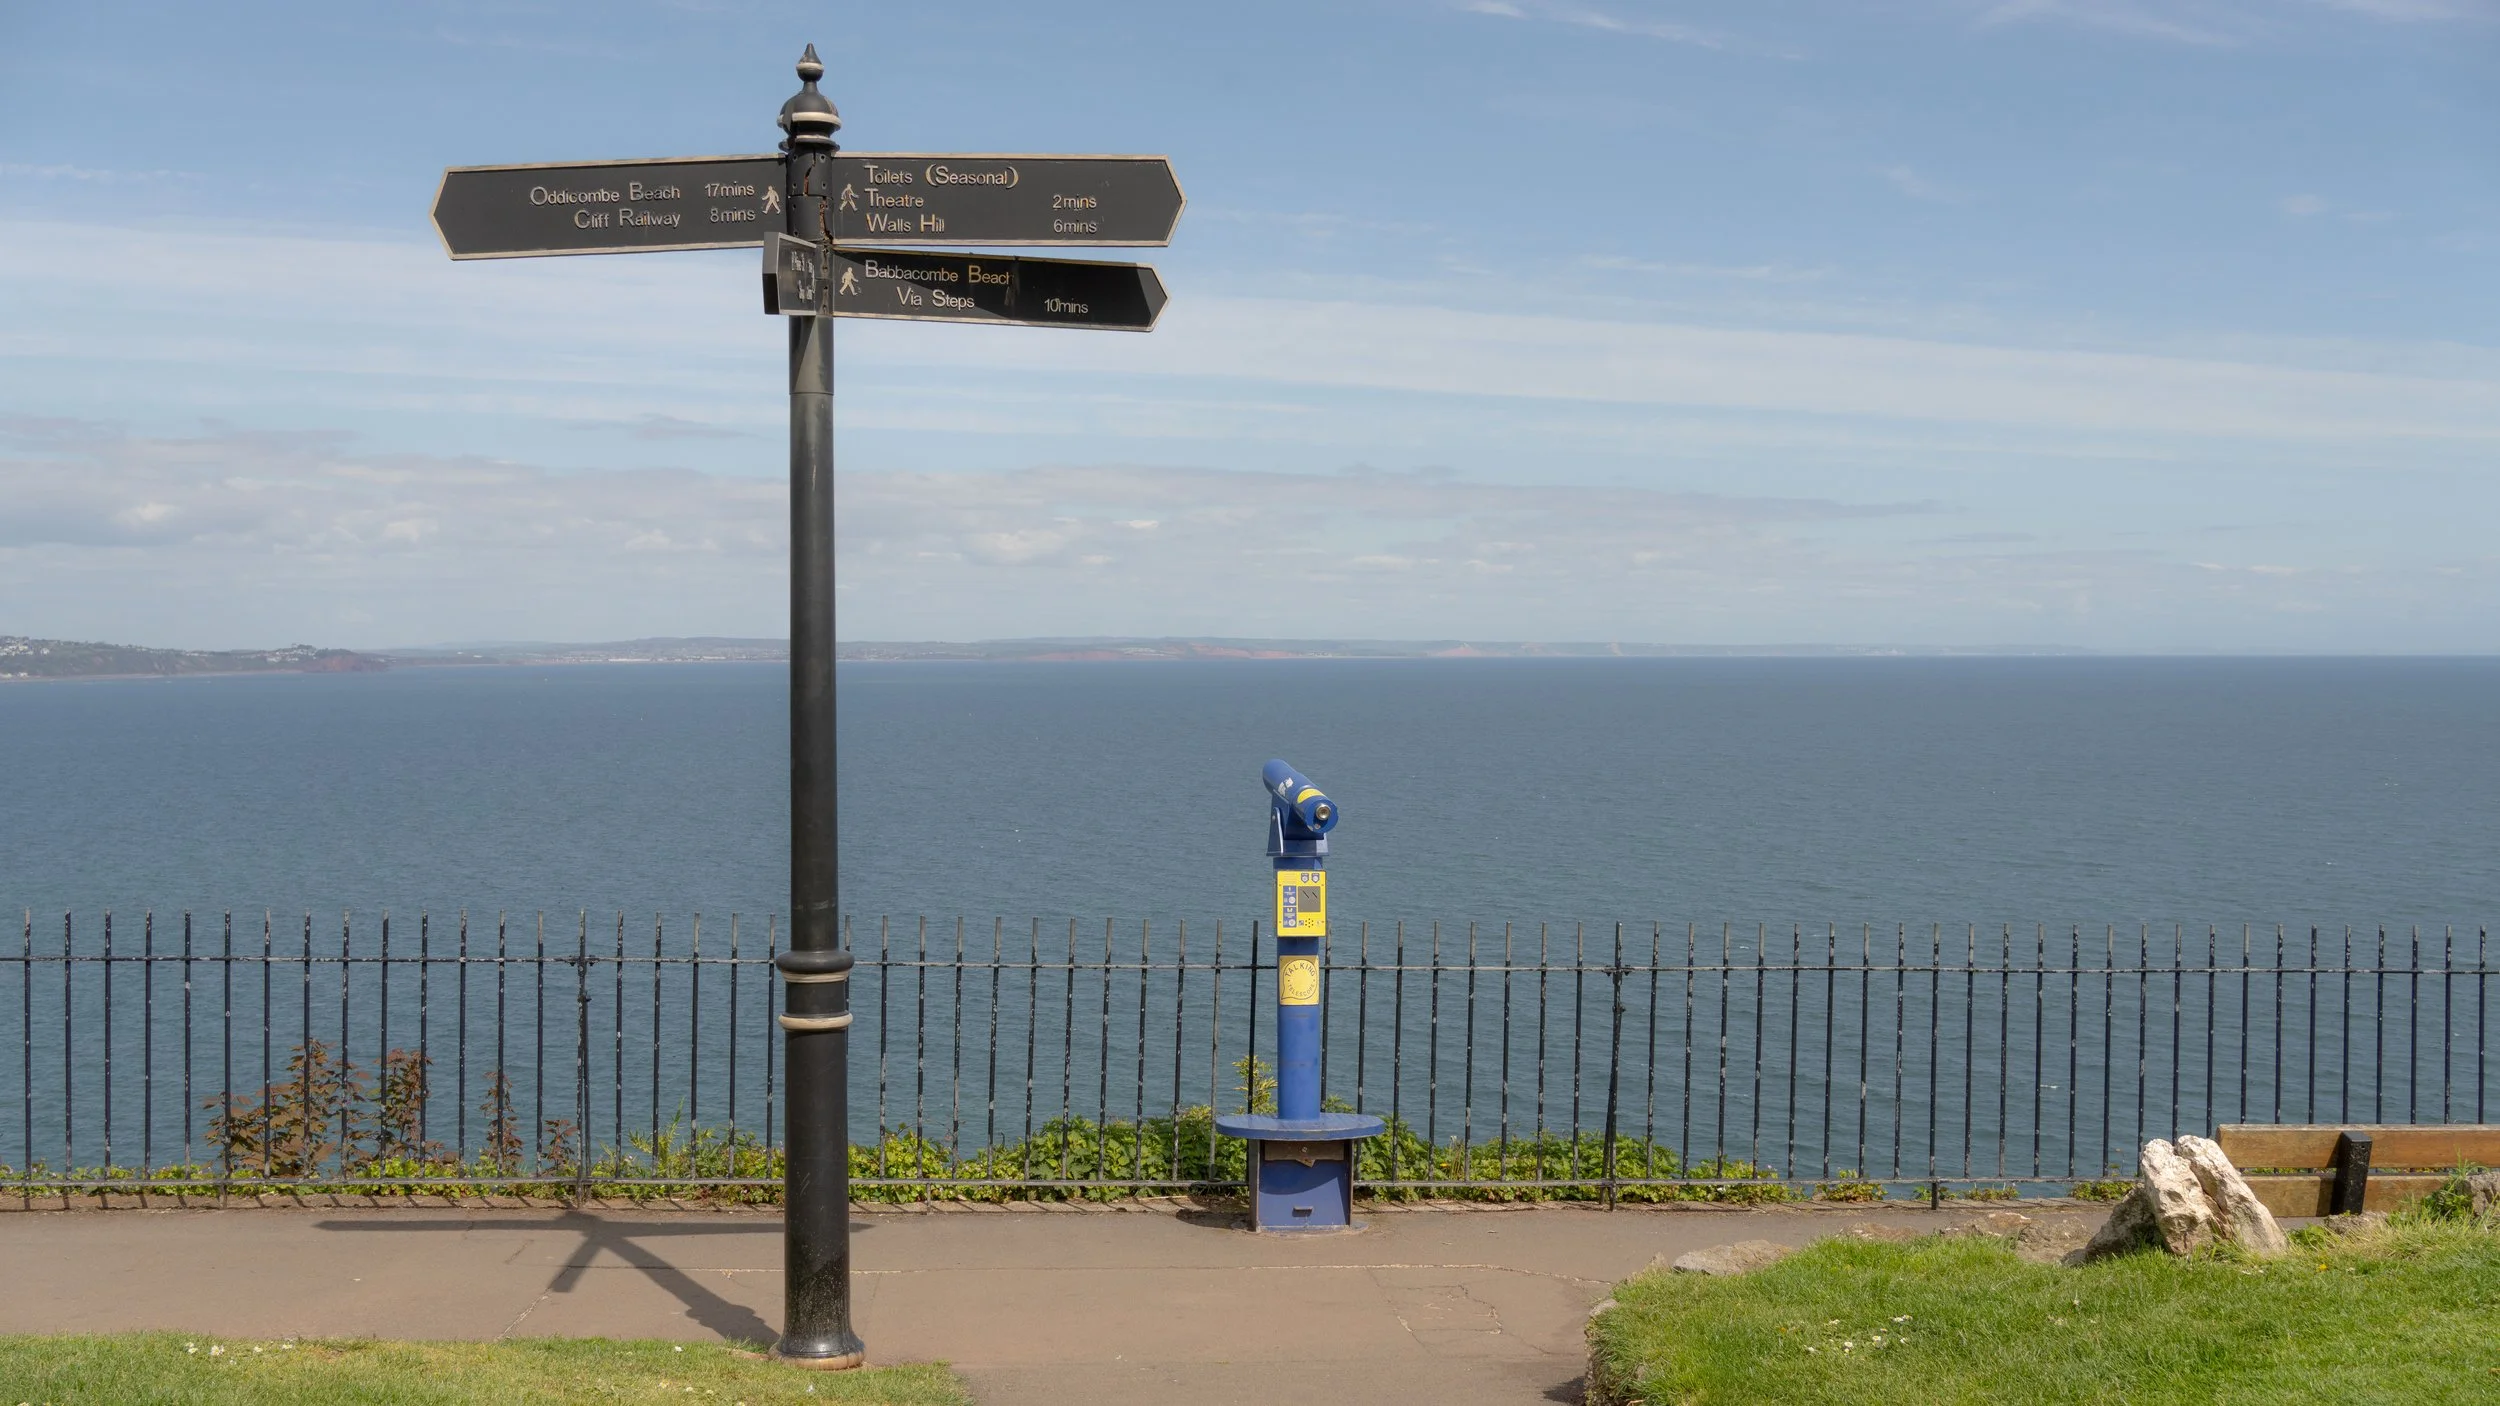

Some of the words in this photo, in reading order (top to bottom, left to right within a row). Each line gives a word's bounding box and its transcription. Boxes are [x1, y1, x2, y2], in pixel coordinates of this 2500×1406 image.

[864, 165, 912, 185] Toilets
[925, 164, 1019, 188] (Seasonal)
[530, 186, 620, 206] Oddicombe
[629, 182, 680, 201] Beach
[704, 182, 755, 198] 17mins
[865, 189, 924, 208] Theatre
[1053, 195, 1097, 211] 2mins
[574, 209, 610, 229] Cliff
[619, 208, 680, 229] Railway
[710, 207, 756, 224] 8mins
[866, 214, 911, 233] Walls
[920, 214, 945, 233] Hill
[1053, 218, 1097, 234] 6mins
[865, 260, 959, 283] Babbacombe
[897, 287, 922, 307] Via
[932, 289, 975, 310] Steps
[1044, 298, 1089, 314] 10mins
[1285, 962, 1316, 977] TALKING
[1288, 984, 1315, 997] TELESCOPE
